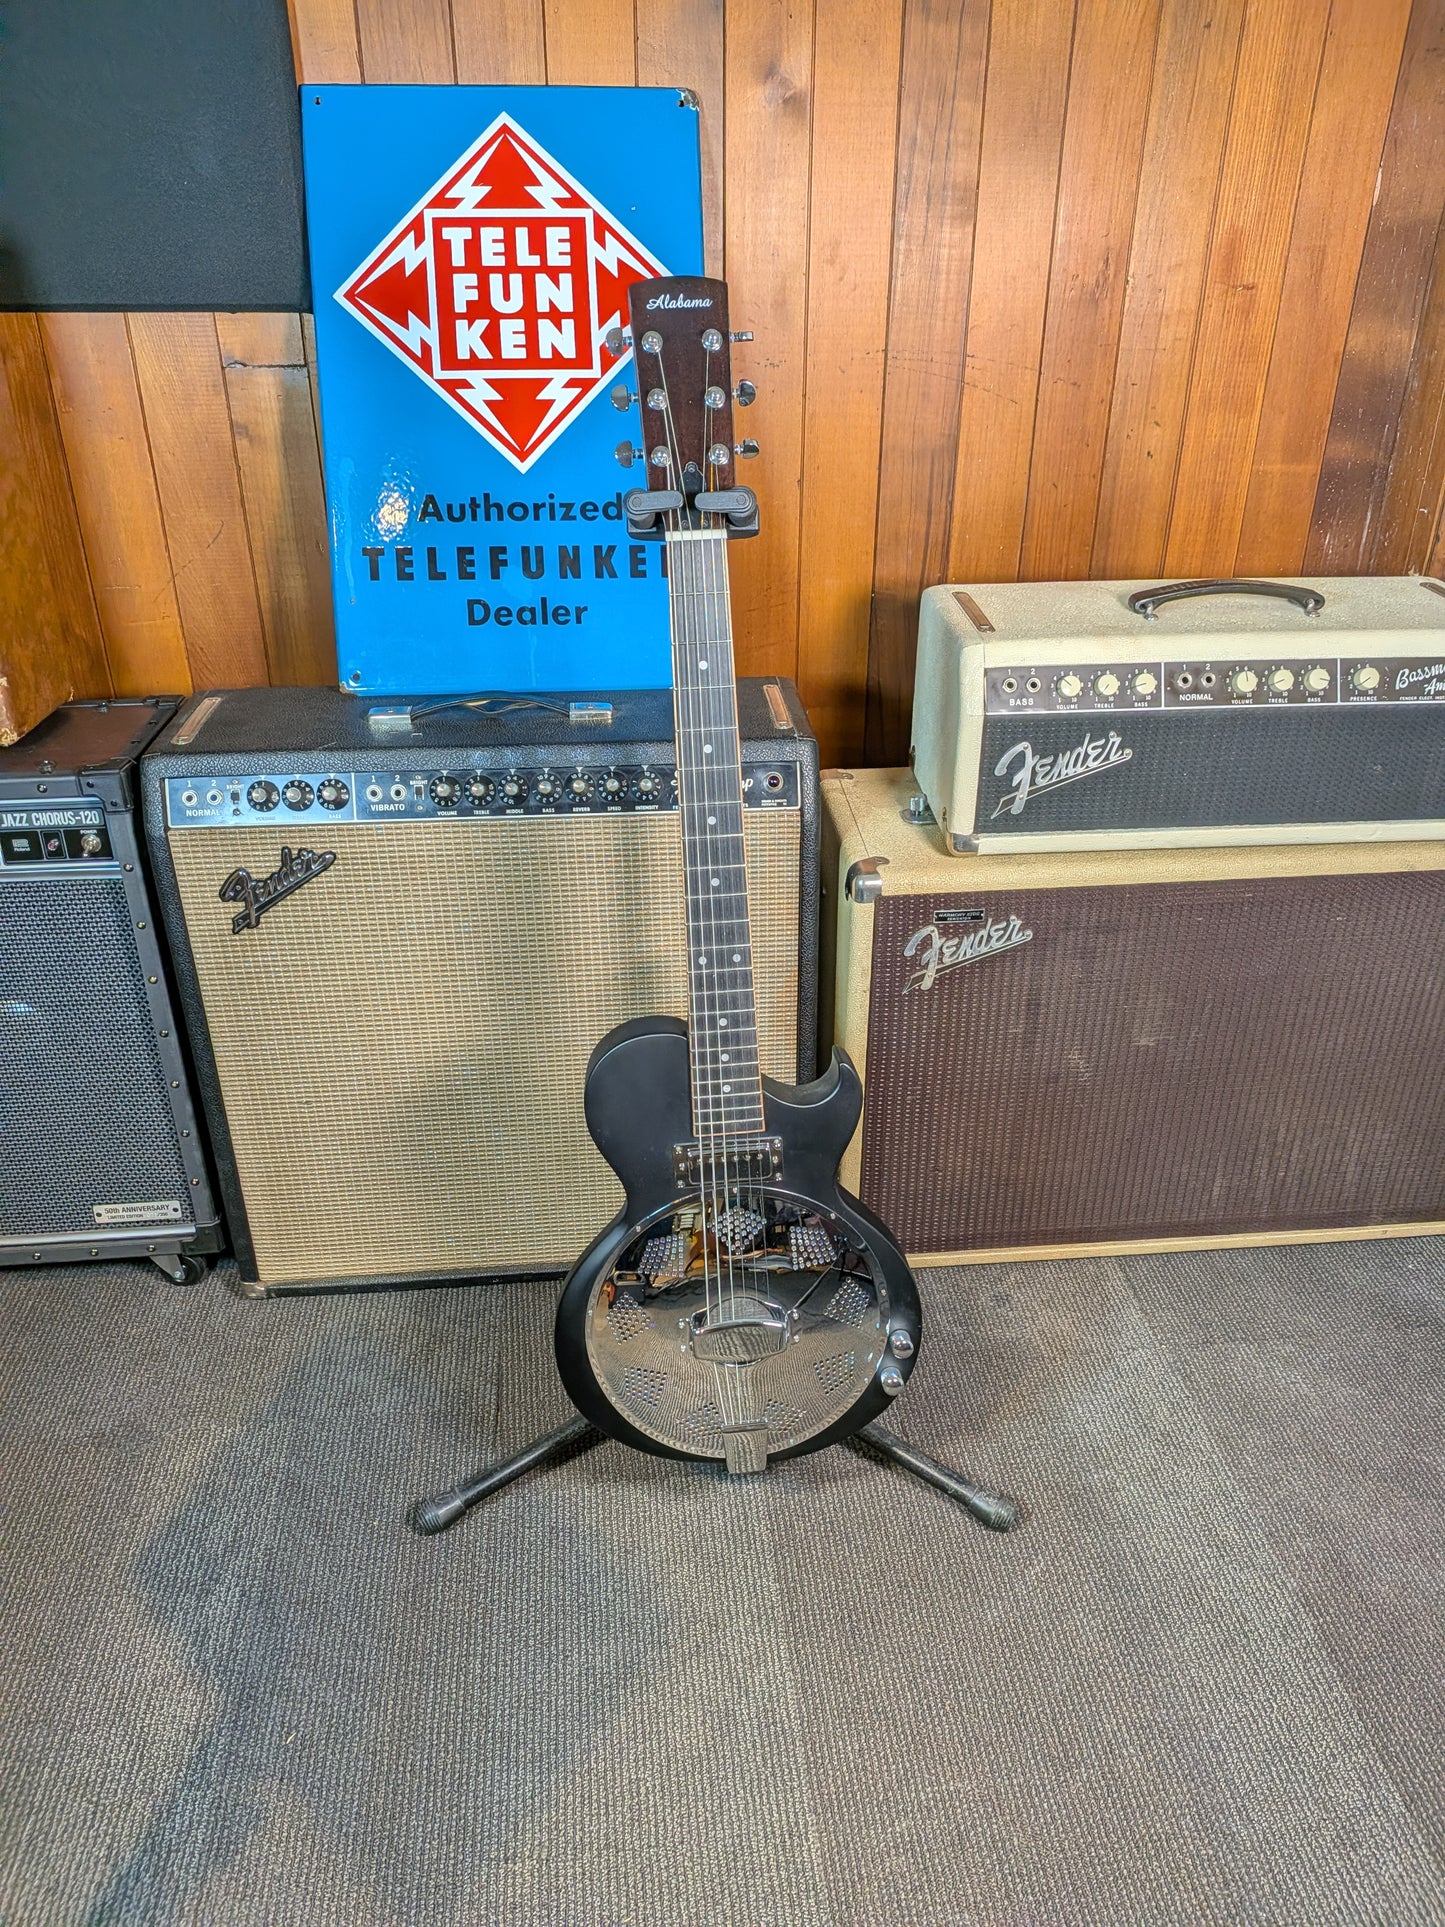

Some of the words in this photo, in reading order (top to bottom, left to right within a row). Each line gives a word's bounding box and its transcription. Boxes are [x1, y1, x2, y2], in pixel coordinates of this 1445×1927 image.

[442, 227, 571, 267] TELE
[454, 273, 573, 313] FUN
[646, 292, 713, 310] Alabama
[455, 319, 576, 360] KEN
[418, 492, 623, 522] Authorized
[467, 597, 588, 626] Dealer
[1, 814, 29, 827] JAZZ
[32, 811, 99, 826] CHORUS-120
[122, 1204, 170, 1212] ANNIVERSARY
